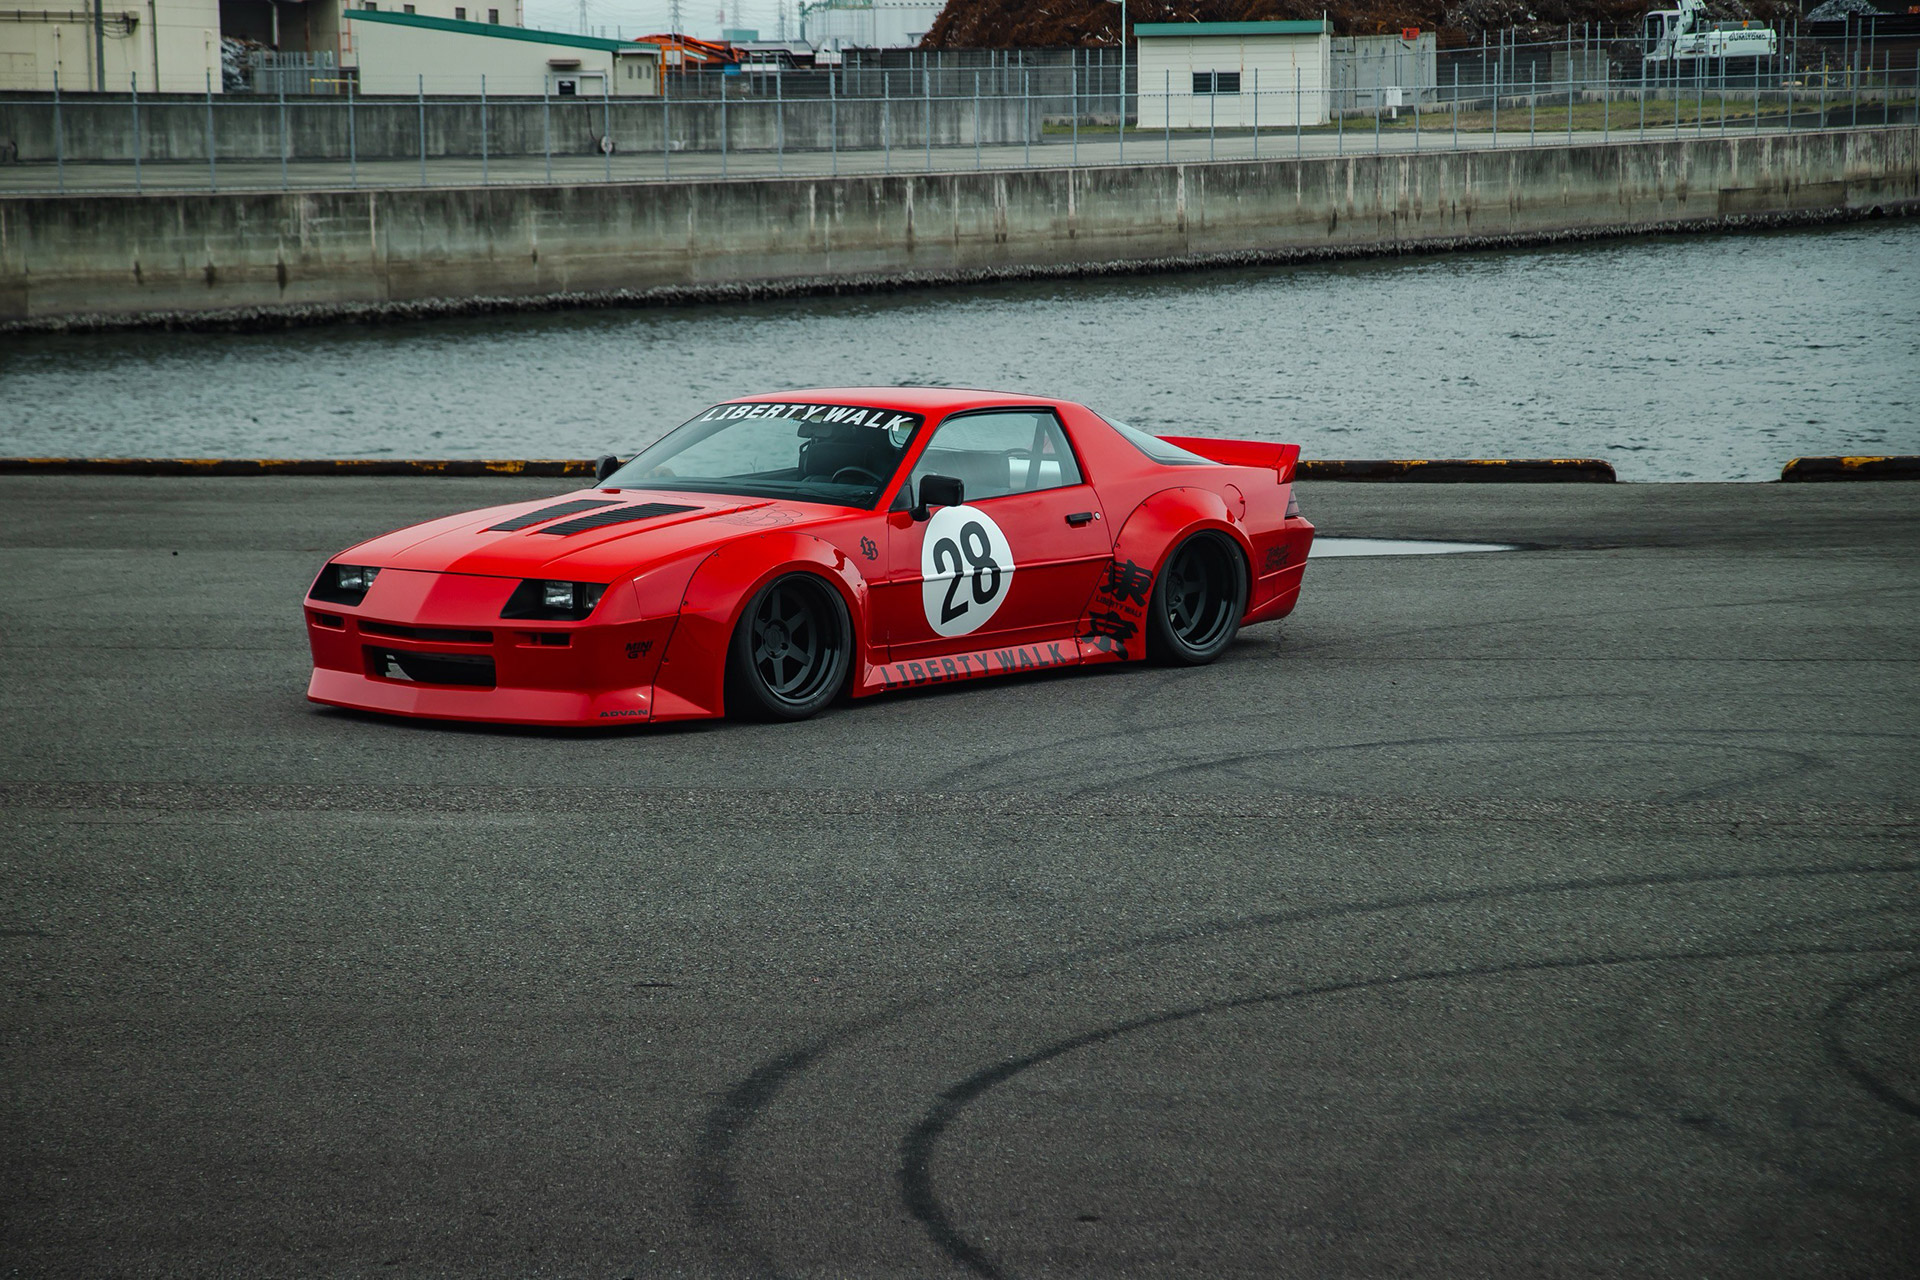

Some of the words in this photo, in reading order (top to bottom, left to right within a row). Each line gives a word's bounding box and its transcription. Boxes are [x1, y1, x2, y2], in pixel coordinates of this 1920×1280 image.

[700, 403, 827, 422] LIBERTY
[823, 407, 914, 432] WALK
[933, 521, 1000, 625] 28
[625, 640, 653, 651] MINI
[627, 650, 647, 659] GT
[880, 653, 989, 688] LIBERTY
[994, 643, 1066, 672] WALK
[600, 709, 648, 717] ADVAN
